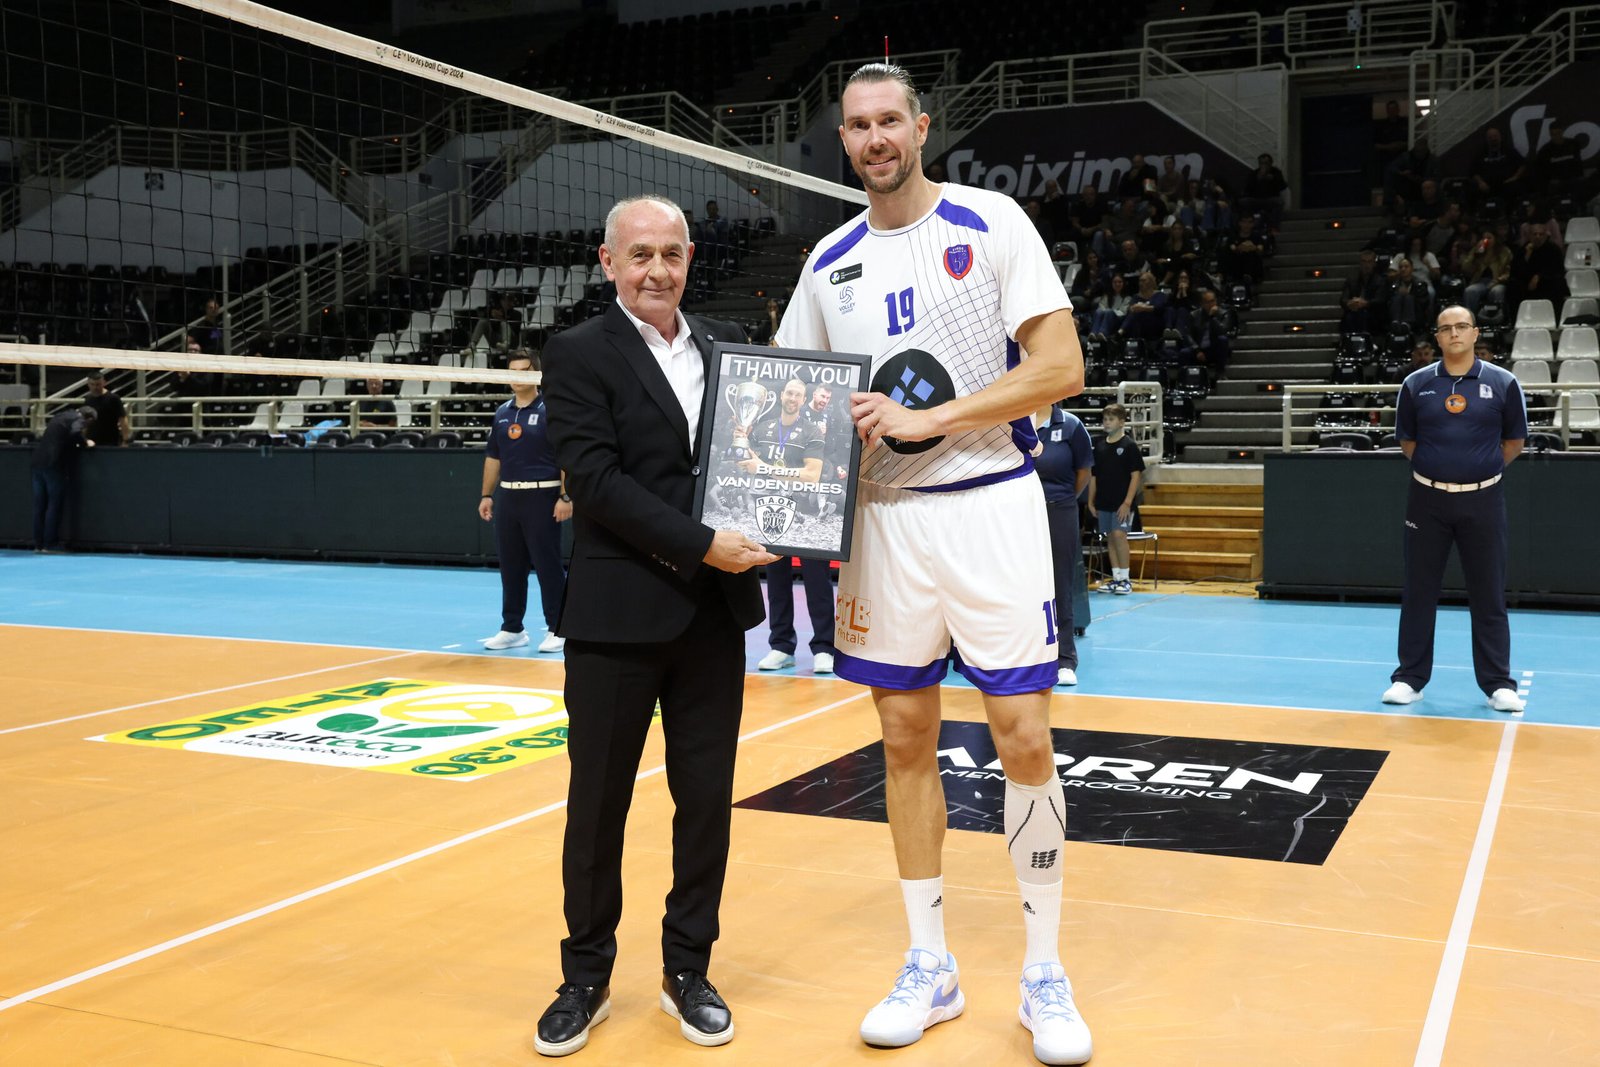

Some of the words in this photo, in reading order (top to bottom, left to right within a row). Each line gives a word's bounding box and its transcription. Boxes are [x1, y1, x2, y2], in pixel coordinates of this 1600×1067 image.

[436, 64, 449, 76] Cup
[449, 68, 464, 79] 2024
[946, 149, 1205, 198] Stoiximn
[884, 286, 916, 337] 19
[733, 359, 802, 380] THANK
[808, 366, 850, 385] YOU
[756, 465, 800, 478] Bram
[716, 476, 751, 489] VAN
[754, 480, 789, 492] DEN
[792, 482, 843, 495] DRIES
[244, 730, 423, 753] auteco
[1030, 861, 1055, 870] cep
